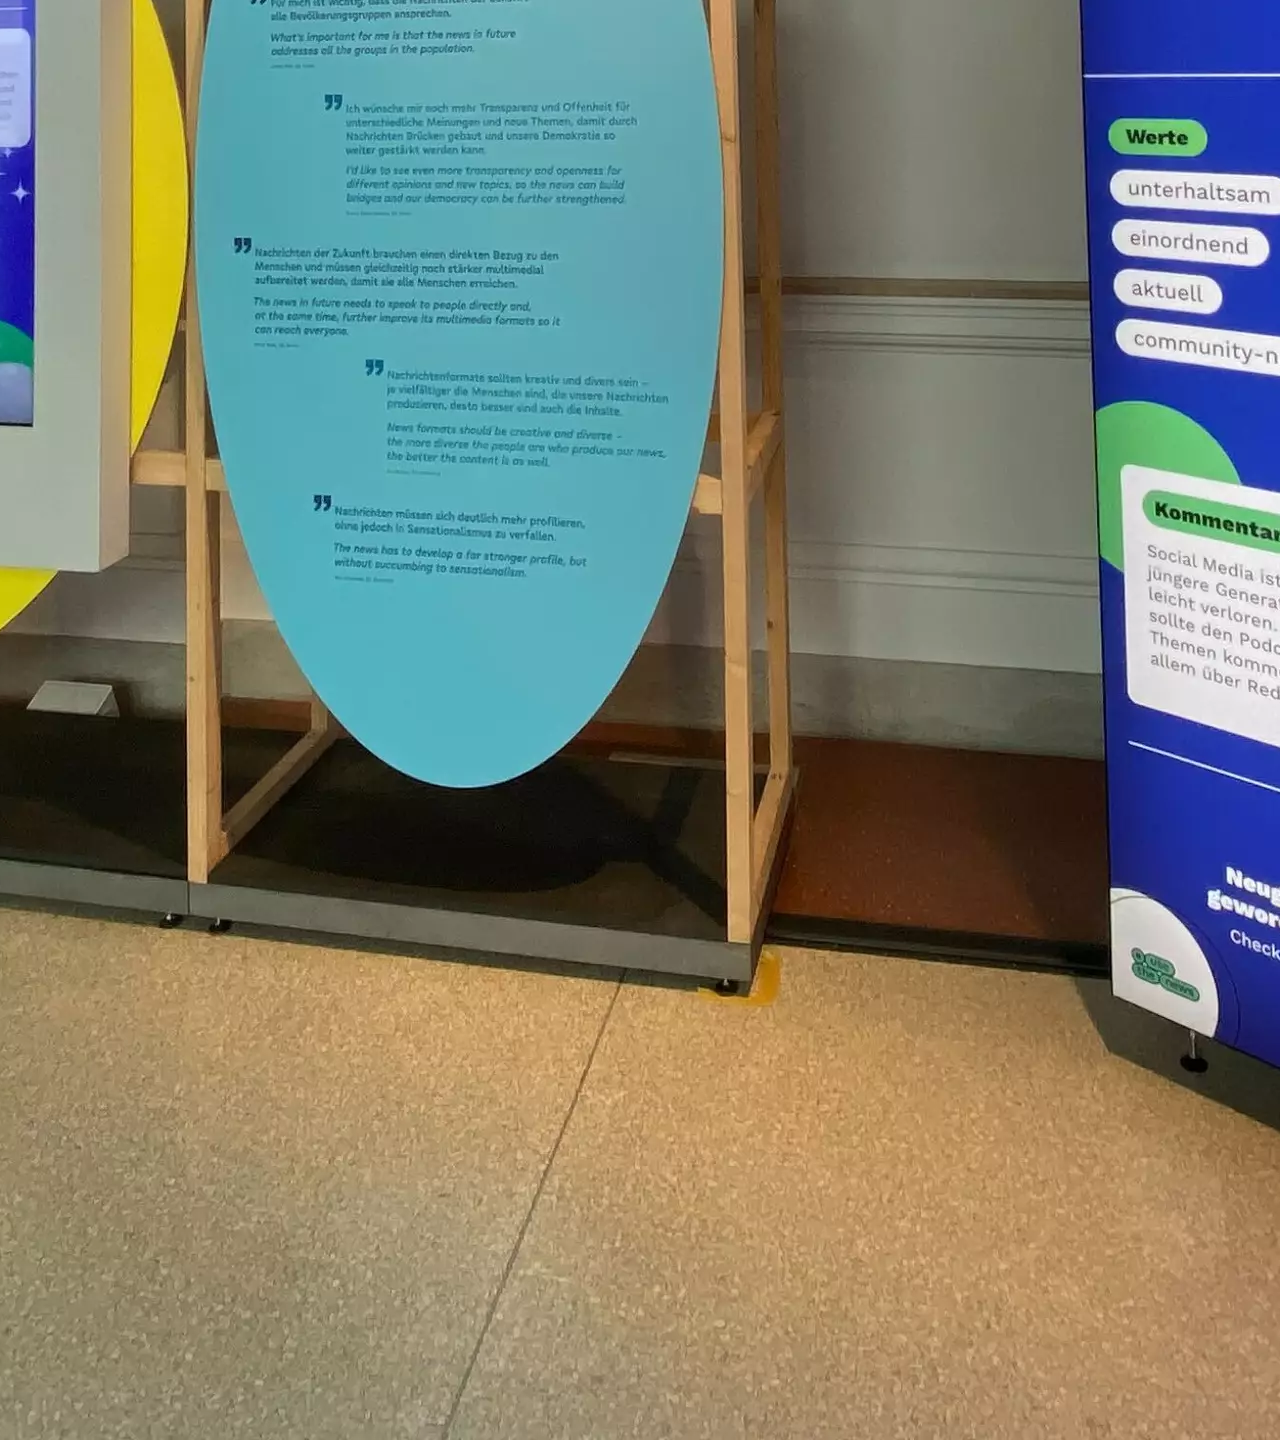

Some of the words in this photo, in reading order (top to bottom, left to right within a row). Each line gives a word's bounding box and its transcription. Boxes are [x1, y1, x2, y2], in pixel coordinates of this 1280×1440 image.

[395, 8, 451, 19] ansprechen.
[306, 31, 355, 44] important
[358, 30, 372, 41] for
[375, 33, 389, 41] me
[392, 30, 400, 41] is
[403, 30, 424, 41] that
[427, 30, 443, 39] the
[446, 31, 470, 40] news
[474, 29, 482, 38] in
[486, 28, 516, 39] future
[321, 45, 333, 56] all
[336, 44, 352, 55] the
[354, 47, 387, 57] groups
[390, 44, 398, 54] in
[402, 44, 417, 54] the
[420, 44, 474, 56] population.
[1125, 128, 1189, 146] Werte
[1127, 179, 1271, 205] unterhaltsam
[1129, 229, 1249, 256] einordnend
[1131, 280, 1204, 304] aktuell
